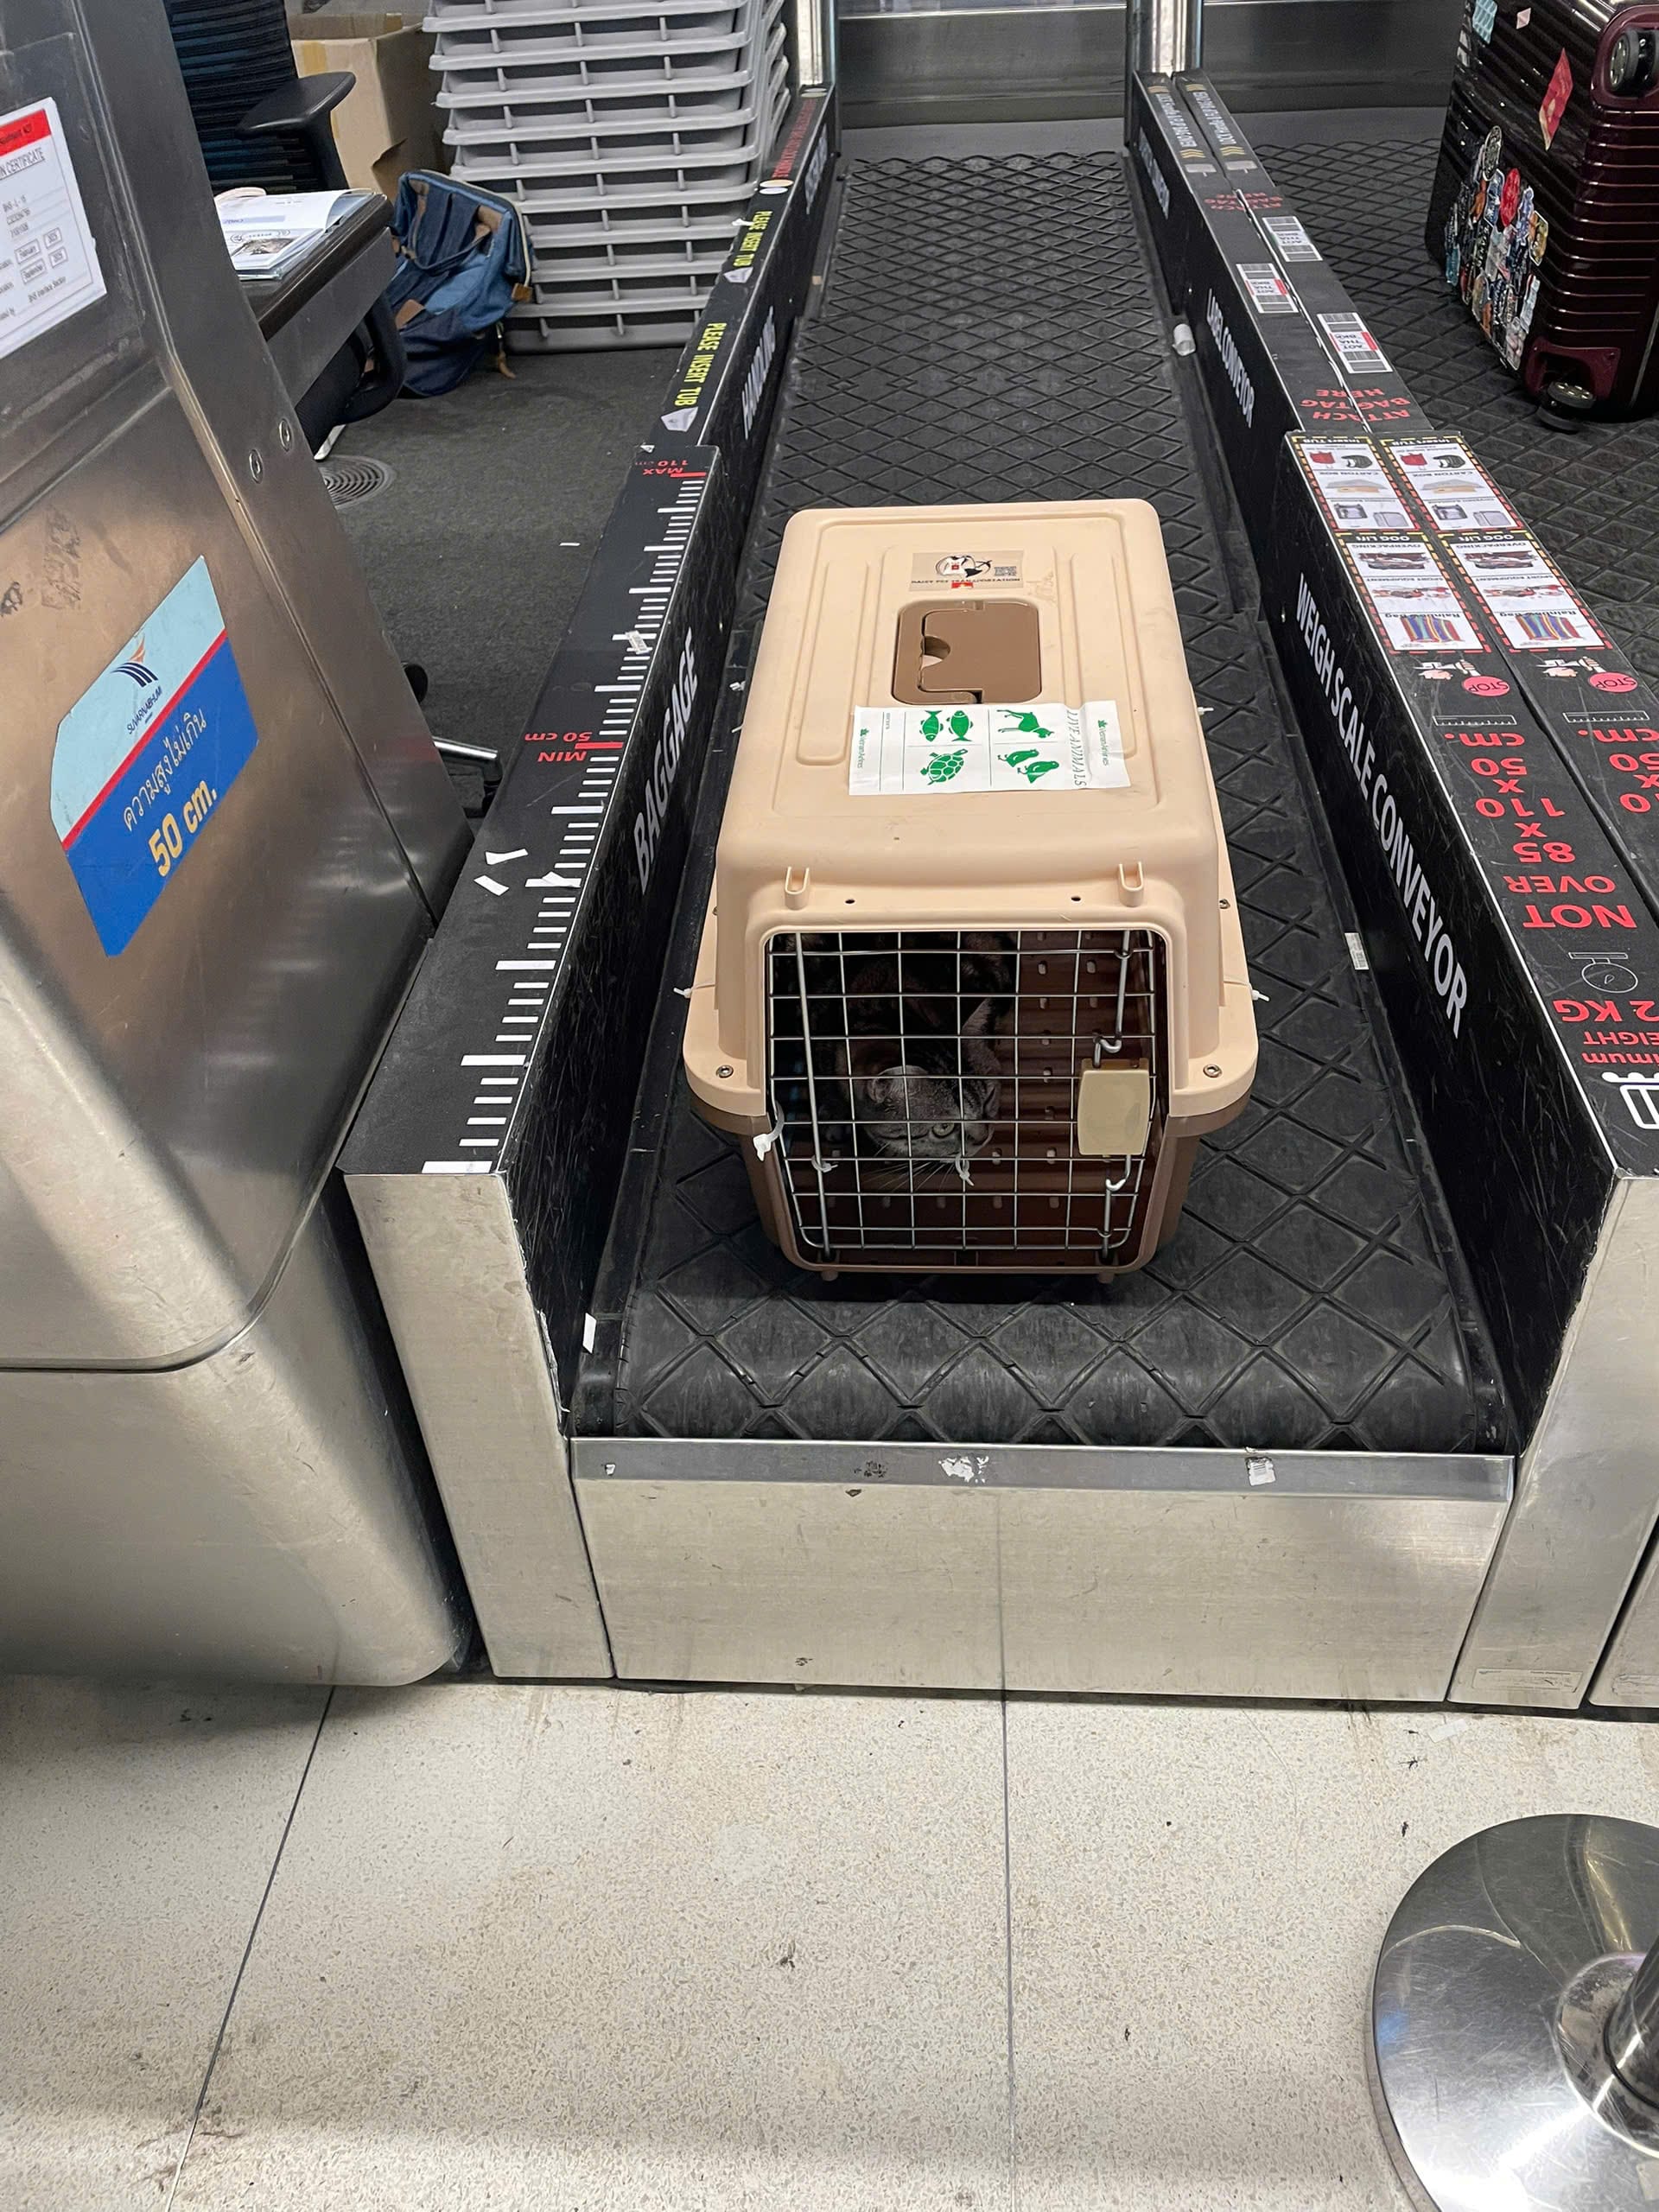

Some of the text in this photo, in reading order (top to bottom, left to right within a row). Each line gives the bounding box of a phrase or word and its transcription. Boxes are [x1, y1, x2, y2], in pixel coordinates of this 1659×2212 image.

[733, 211, 773, 266] PLEASE INSERT TUB
[674, 322, 728, 406] PLEASE INSERT TUB
[1222, 326, 1255, 429] CONVEYOR
[1315, 388, 1387, 398] HERE
[1300, 397, 1412, 410] BAG TAG
[1312, 410, 1411, 423] ATTACH
[1469, 680, 1510, 691] STOP
[1596, 677, 1637, 689] STOP
[524, 731, 593, 741] 50 cm
[1444, 733, 1526, 747] cm.
[1577, 728, 1659, 743] cm.
[537, 750, 588, 762] MIN
[1066, 709, 1087, 785] LIVE ANIMALS
[124, 709, 207, 832] ความสูงไม่เกิน
[634, 626, 698, 896] BAGGAGE
[1471, 757, 1528, 776] 50
[1608, 752, 1659, 772] 50
[1296, 572, 1468, 1039] WEIGH SCALE CONVEYOR
[1475, 797, 1566, 817] 110
[148, 779, 219, 877] 50 cm.
[1512, 842, 1576, 863] 85
[1502, 874, 1618, 893] OVER
[1522, 904, 1638, 929] NOT
[1552, 1000, 1623, 1022] KG
